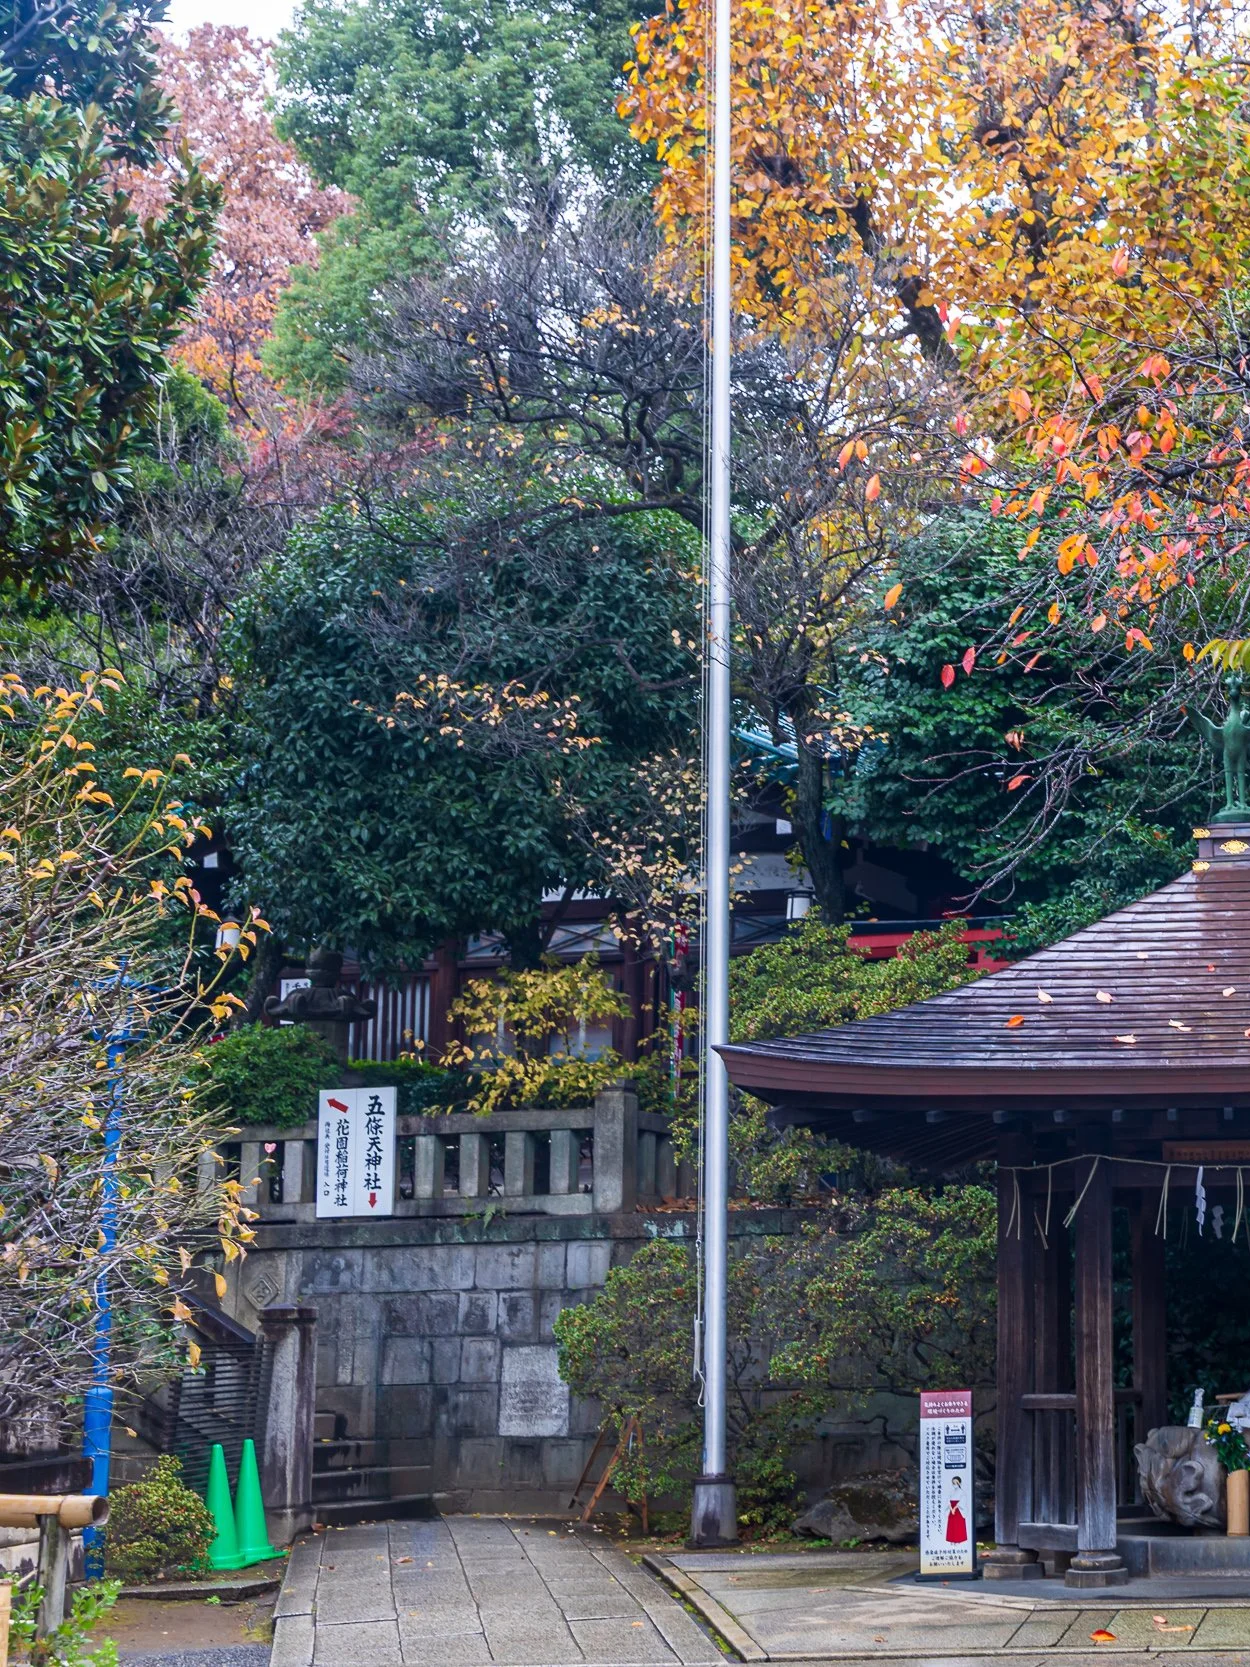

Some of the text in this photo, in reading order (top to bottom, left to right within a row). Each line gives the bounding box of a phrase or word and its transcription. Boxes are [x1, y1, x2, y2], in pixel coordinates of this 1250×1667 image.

[333, 1118, 350, 1207] 花園稲荷神社
[363, 1094, 386, 1191] 五條天神社
